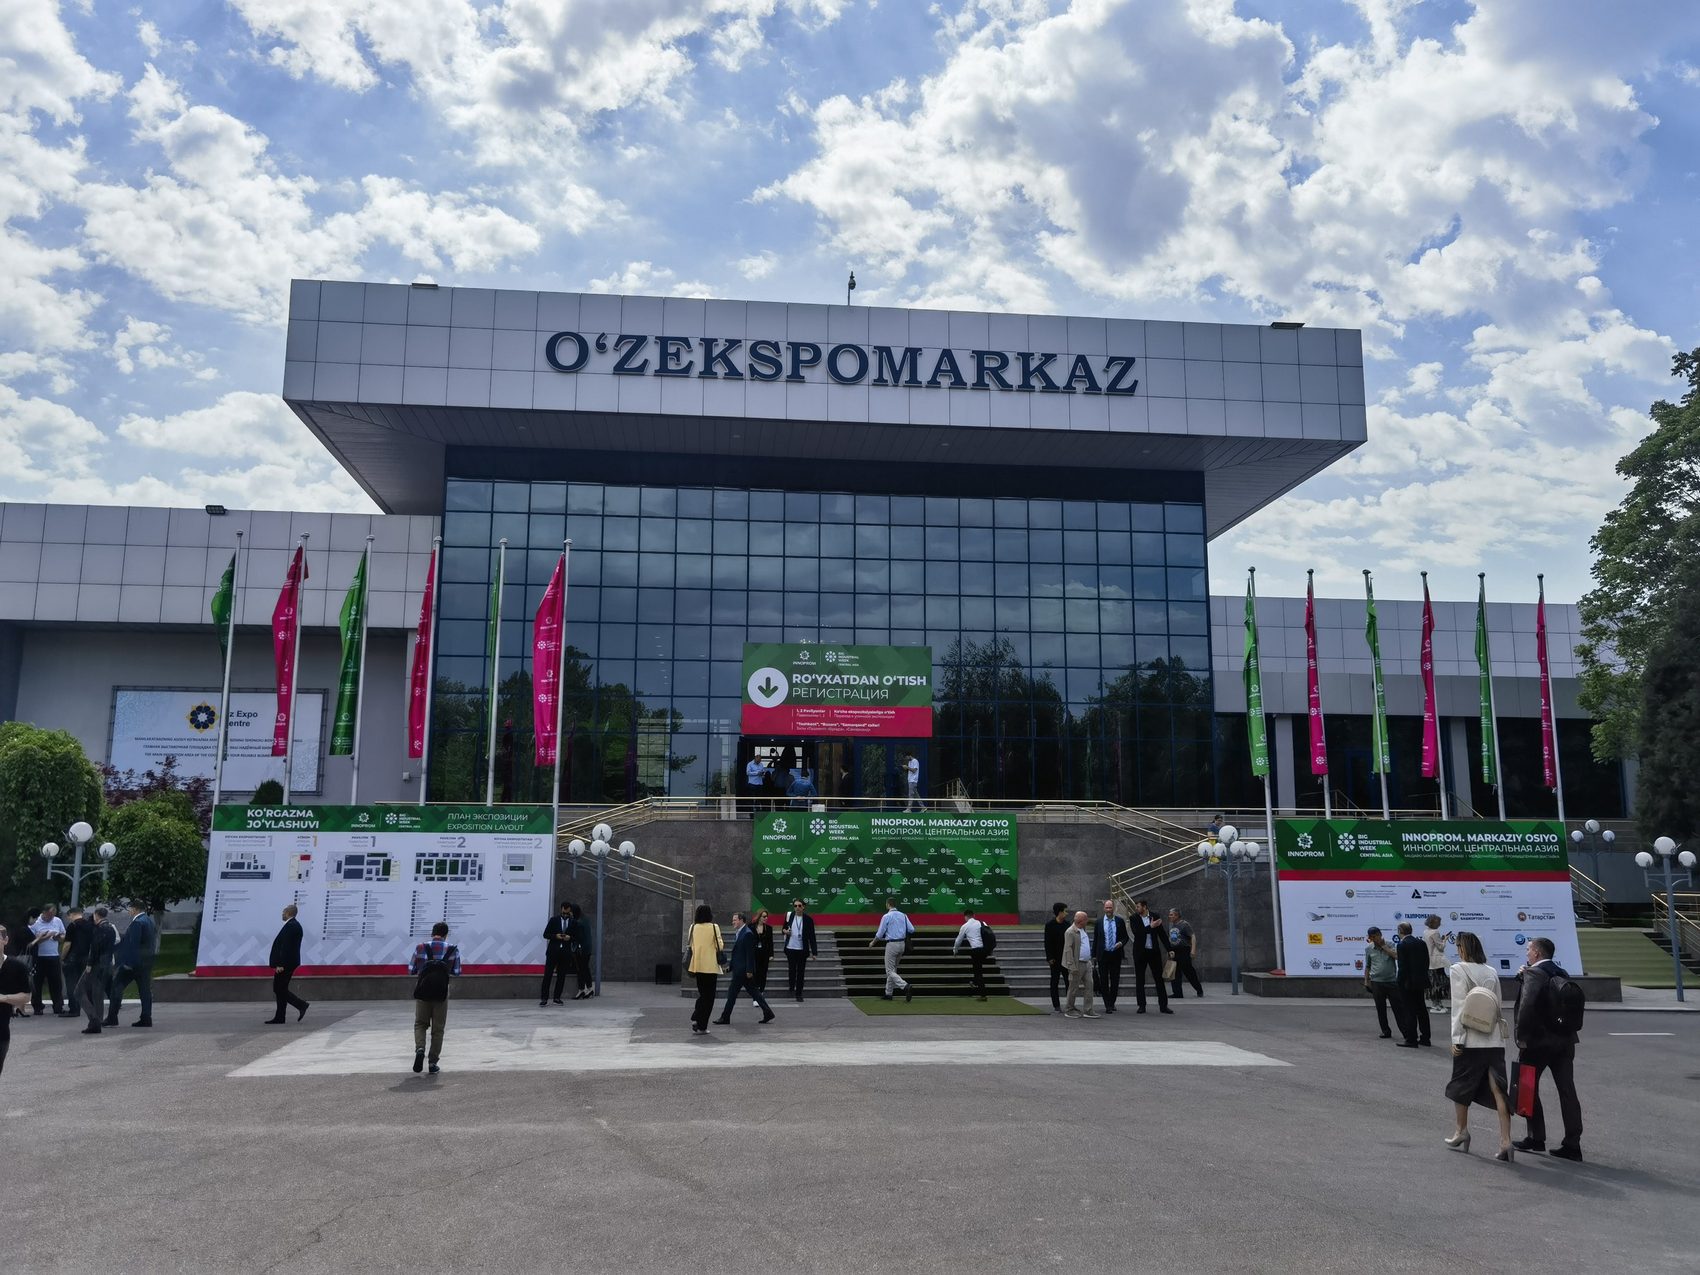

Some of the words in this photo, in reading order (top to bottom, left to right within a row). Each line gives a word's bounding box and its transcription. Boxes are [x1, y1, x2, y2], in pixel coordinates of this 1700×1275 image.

[545, 331, 1139, 396] O‘ZEKSPOMARKAZ
[792, 674, 879, 685] RO‘YXATDAN
[882, 675, 927, 686] O‘TISH
[792, 687, 889, 701] РЕГИСТРАЦИЯ
[236, 710, 258, 719] Expo
[247, 808, 314, 818] KO‘RGAZMA
[472, 813, 528, 822] ЭКСПОЗИЦИИ
[246, 818, 320, 829] JO‘YLASHUVI
[447, 823, 493, 831] EXPOSITION
[871, 818, 927, 826] INNOPROM.
[928, 819, 978, 827] MARKAZIY
[980, 819, 1009, 827] OSIYO
[925, 828, 985, 836] ЦЕНТРАЛЬНАЯ
[987, 828, 1009, 836] АЗИЯ
[457, 836, 466, 848] 2
[1401, 833, 1465, 842] INNOPROM.
[1467, 833, 1522, 843] MARKAZIY
[1525, 833, 1558, 843] OSIYO
[1403, 844, 1462, 852] ИННОПРОМ.
[1464, 844, 1532, 854] ЦЕНТРАЛЬНАЯ
[1535, 845, 1560, 853] АЗИЯ
